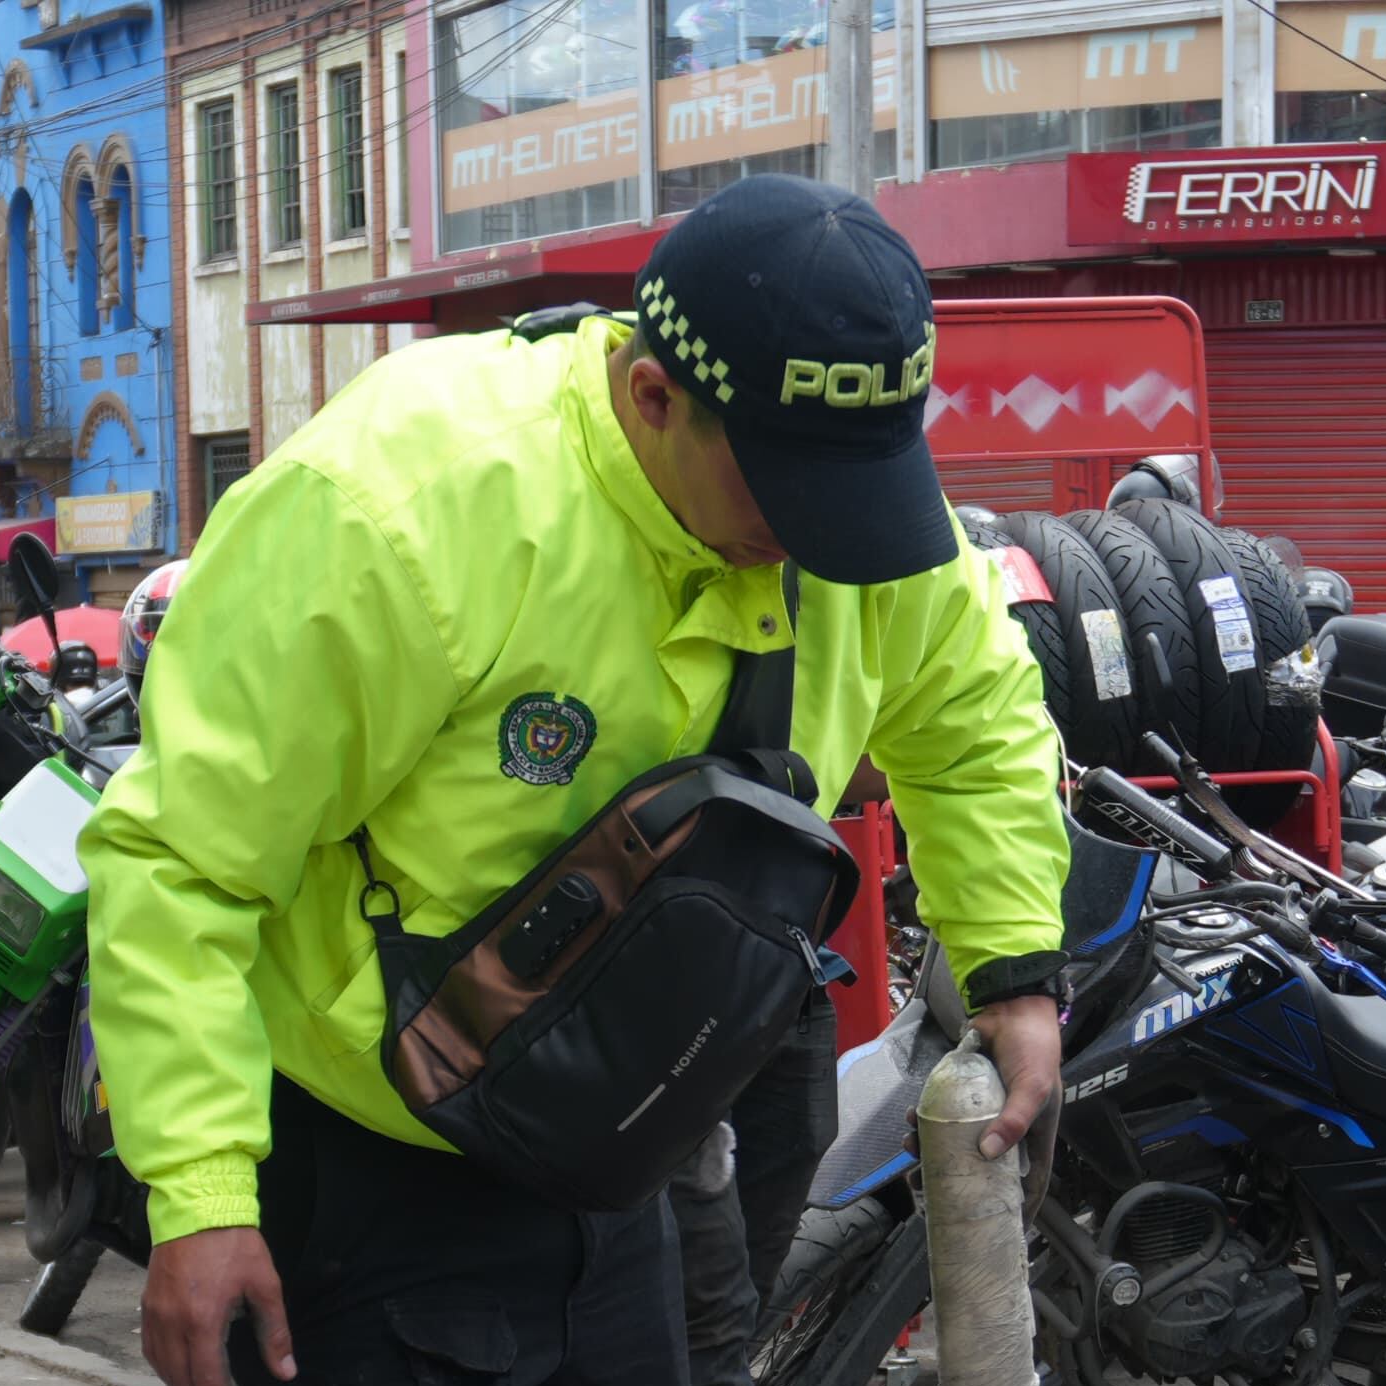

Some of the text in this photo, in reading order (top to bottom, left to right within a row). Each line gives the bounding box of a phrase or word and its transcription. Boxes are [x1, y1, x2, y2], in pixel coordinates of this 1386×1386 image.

[1085, 26, 1197, 79] MT
[1123, 155, 1379, 223] FERRINI
[1146, 214, 1363, 231] DISTRIBUIDORA
[1199, 954, 1245, 978] VICTORY
[670, 1016, 718, 1077] FASHION
[1064, 1064, 1129, 1104] 125
